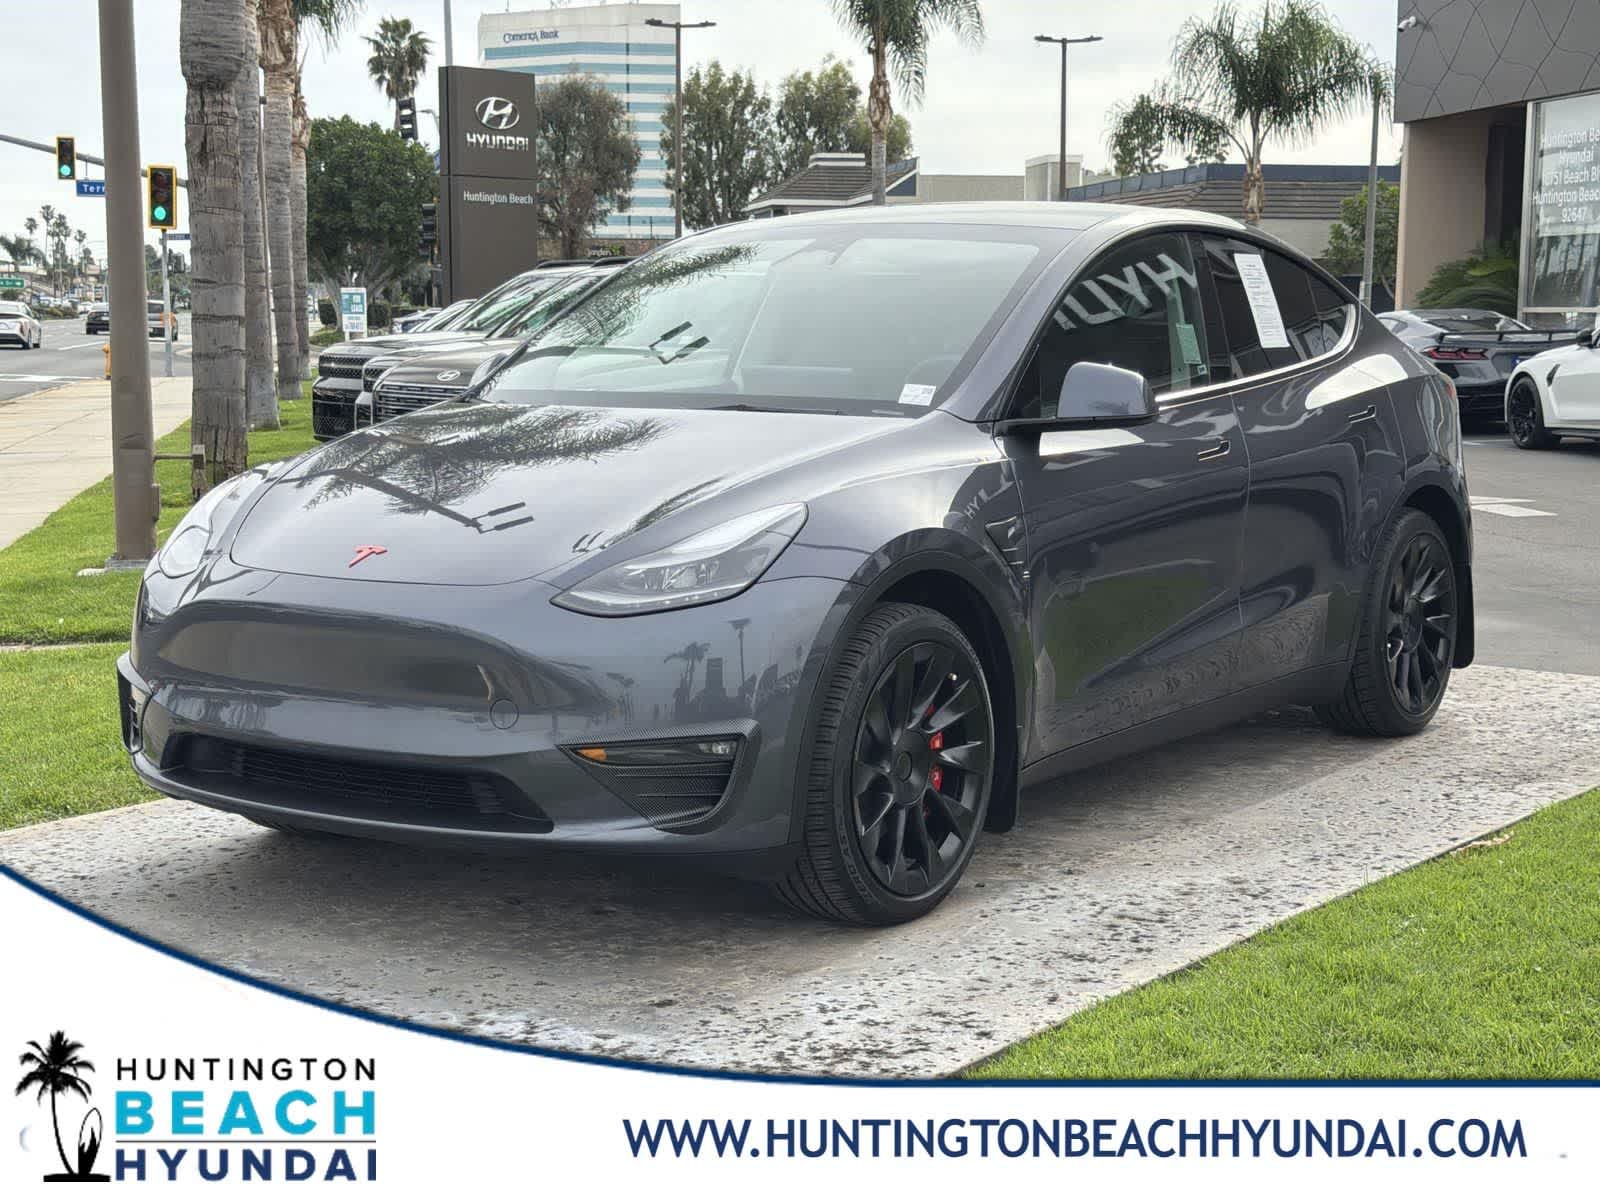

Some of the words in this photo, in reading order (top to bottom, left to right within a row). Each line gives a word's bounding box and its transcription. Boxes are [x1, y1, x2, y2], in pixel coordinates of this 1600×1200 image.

[540, 30, 560, 40] Bank
[465, 132, 529, 152] HYUNDAI
[1564, 166, 1589, 185] Beach
[463, 189, 508, 205] Huntington
[509, 192, 534, 205] Beach
[1533, 189, 1577, 207] Huntington
